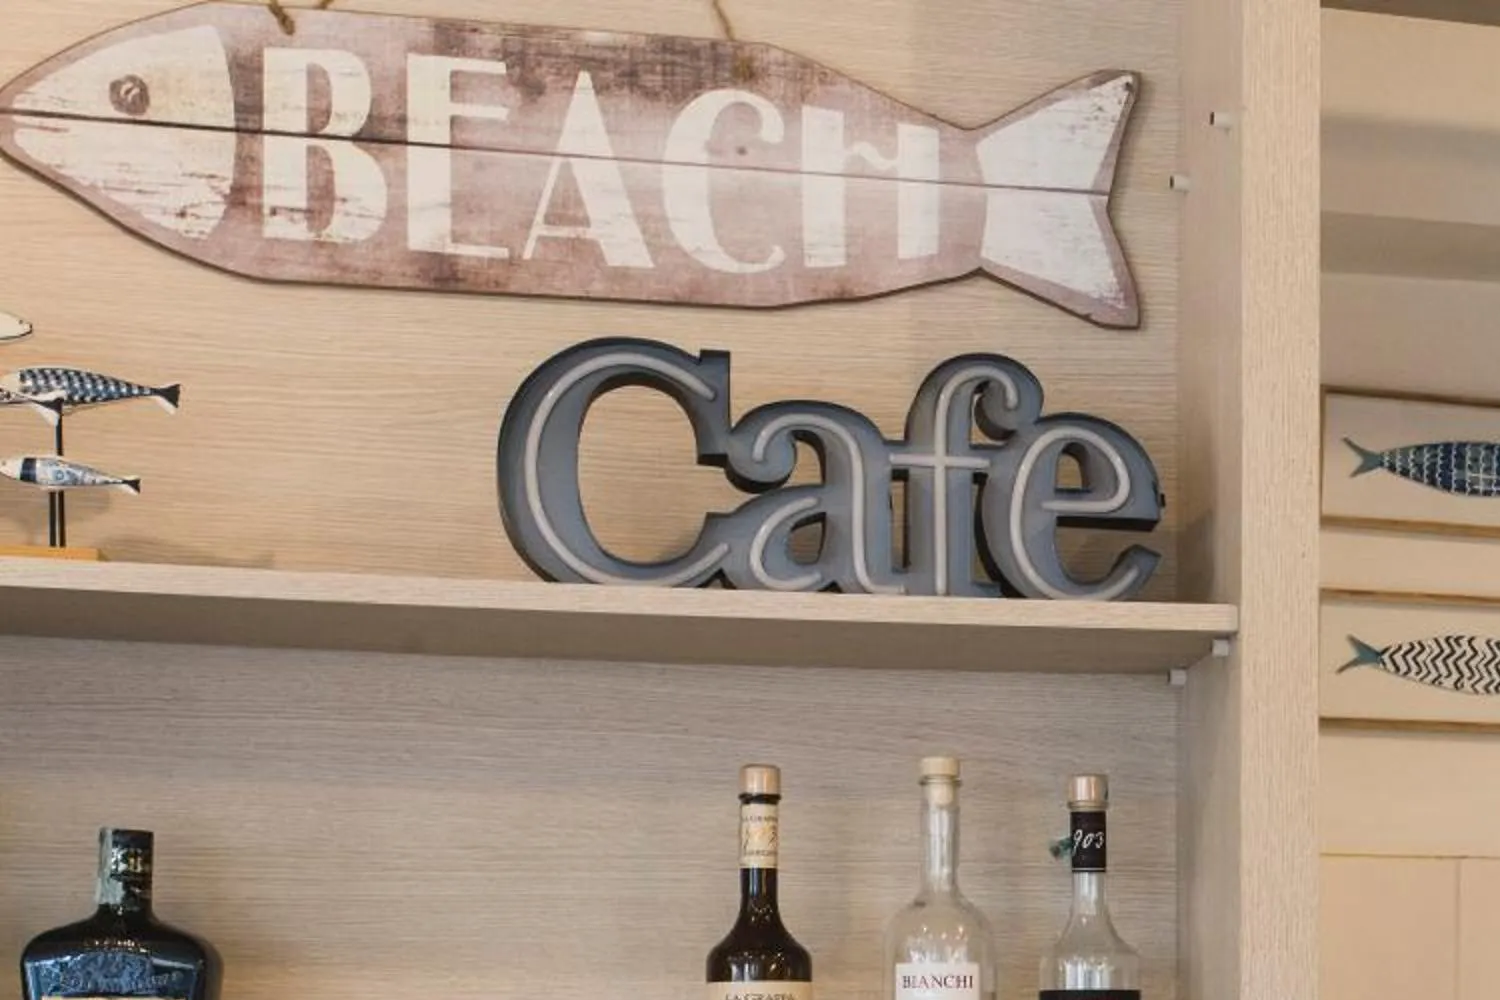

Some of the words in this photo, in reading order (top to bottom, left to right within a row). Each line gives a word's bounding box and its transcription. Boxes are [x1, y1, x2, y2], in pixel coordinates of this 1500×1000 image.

[260, 46, 941, 275] BEACH
[497, 336, 1163, 600] Cafe
[1072, 829, 1105, 856] 903
[902, 975, 974, 989] BIANCHI
